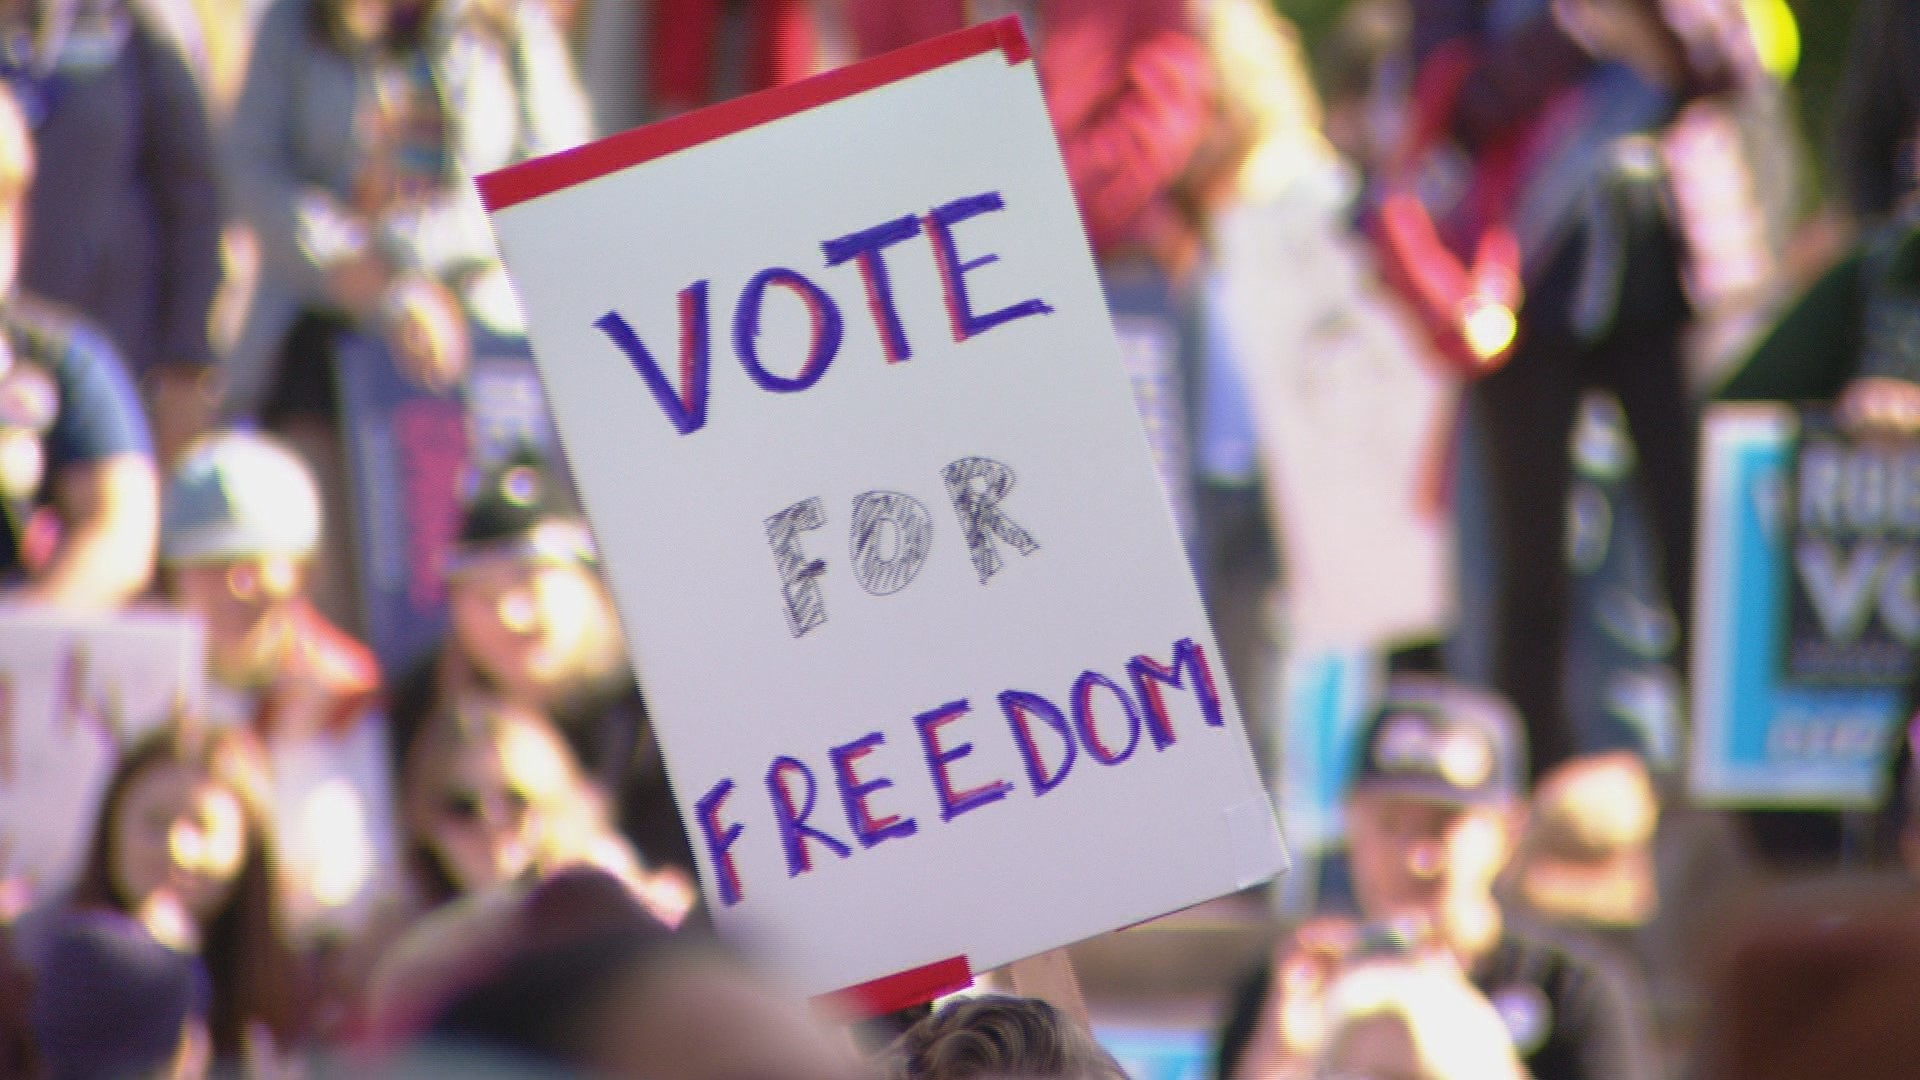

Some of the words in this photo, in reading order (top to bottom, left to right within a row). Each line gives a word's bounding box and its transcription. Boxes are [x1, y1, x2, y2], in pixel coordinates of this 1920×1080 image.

[593, 191, 1055, 436] VOTE
[762, 456, 1041, 638] FOR
[693, 637, 1225, 906] FREEDOM
